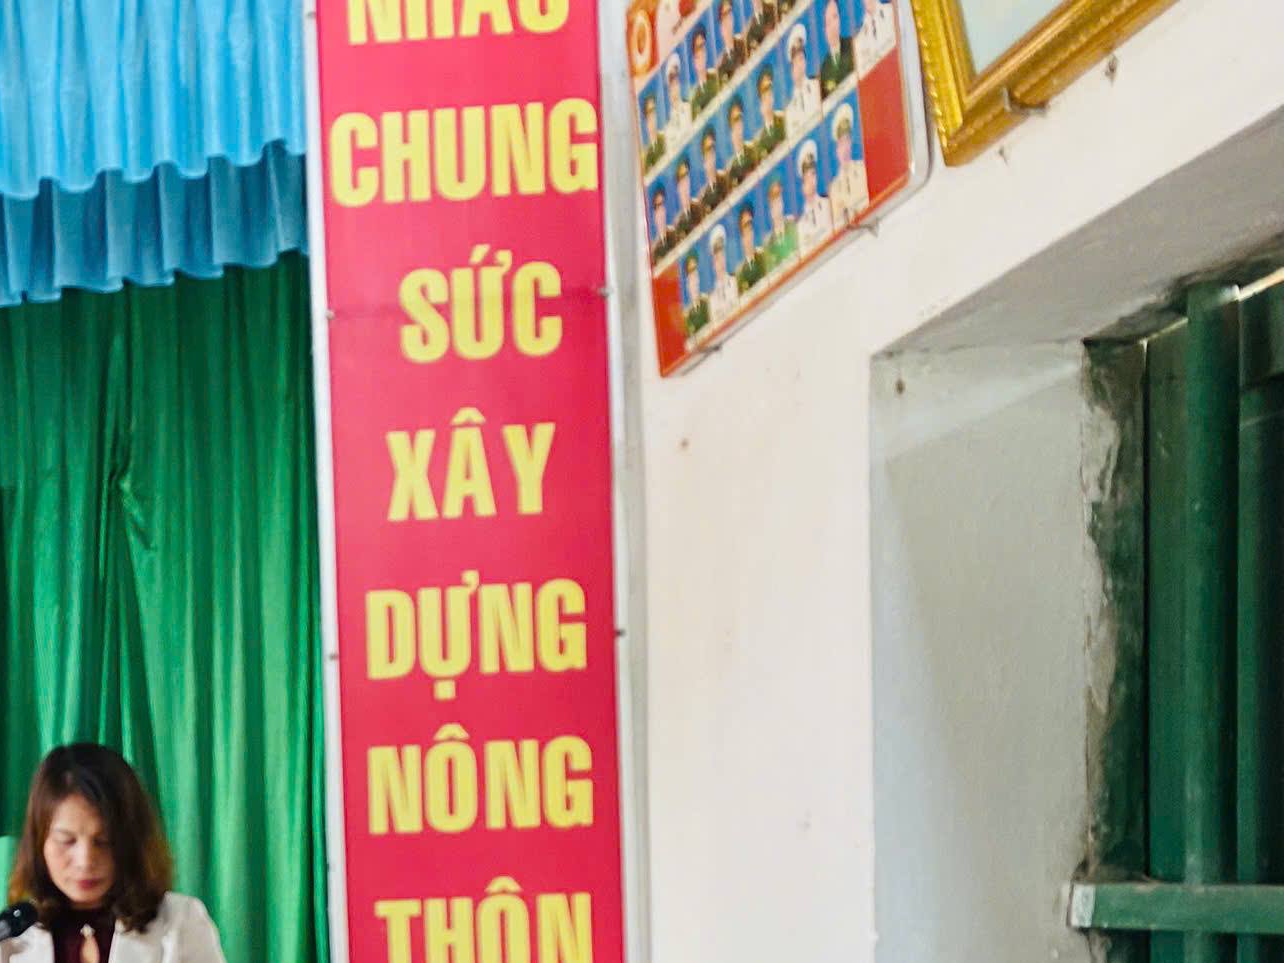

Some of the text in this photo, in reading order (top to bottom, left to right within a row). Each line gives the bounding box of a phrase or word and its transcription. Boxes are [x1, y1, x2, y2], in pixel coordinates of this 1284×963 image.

[330, 98, 599, 208] CHUNG
[399, 244, 562, 363] SỨC
[386, 407, 556, 521] XÂY
[365, 570, 587, 700] DỰNG
[367, 723, 594, 836] NÔNG
